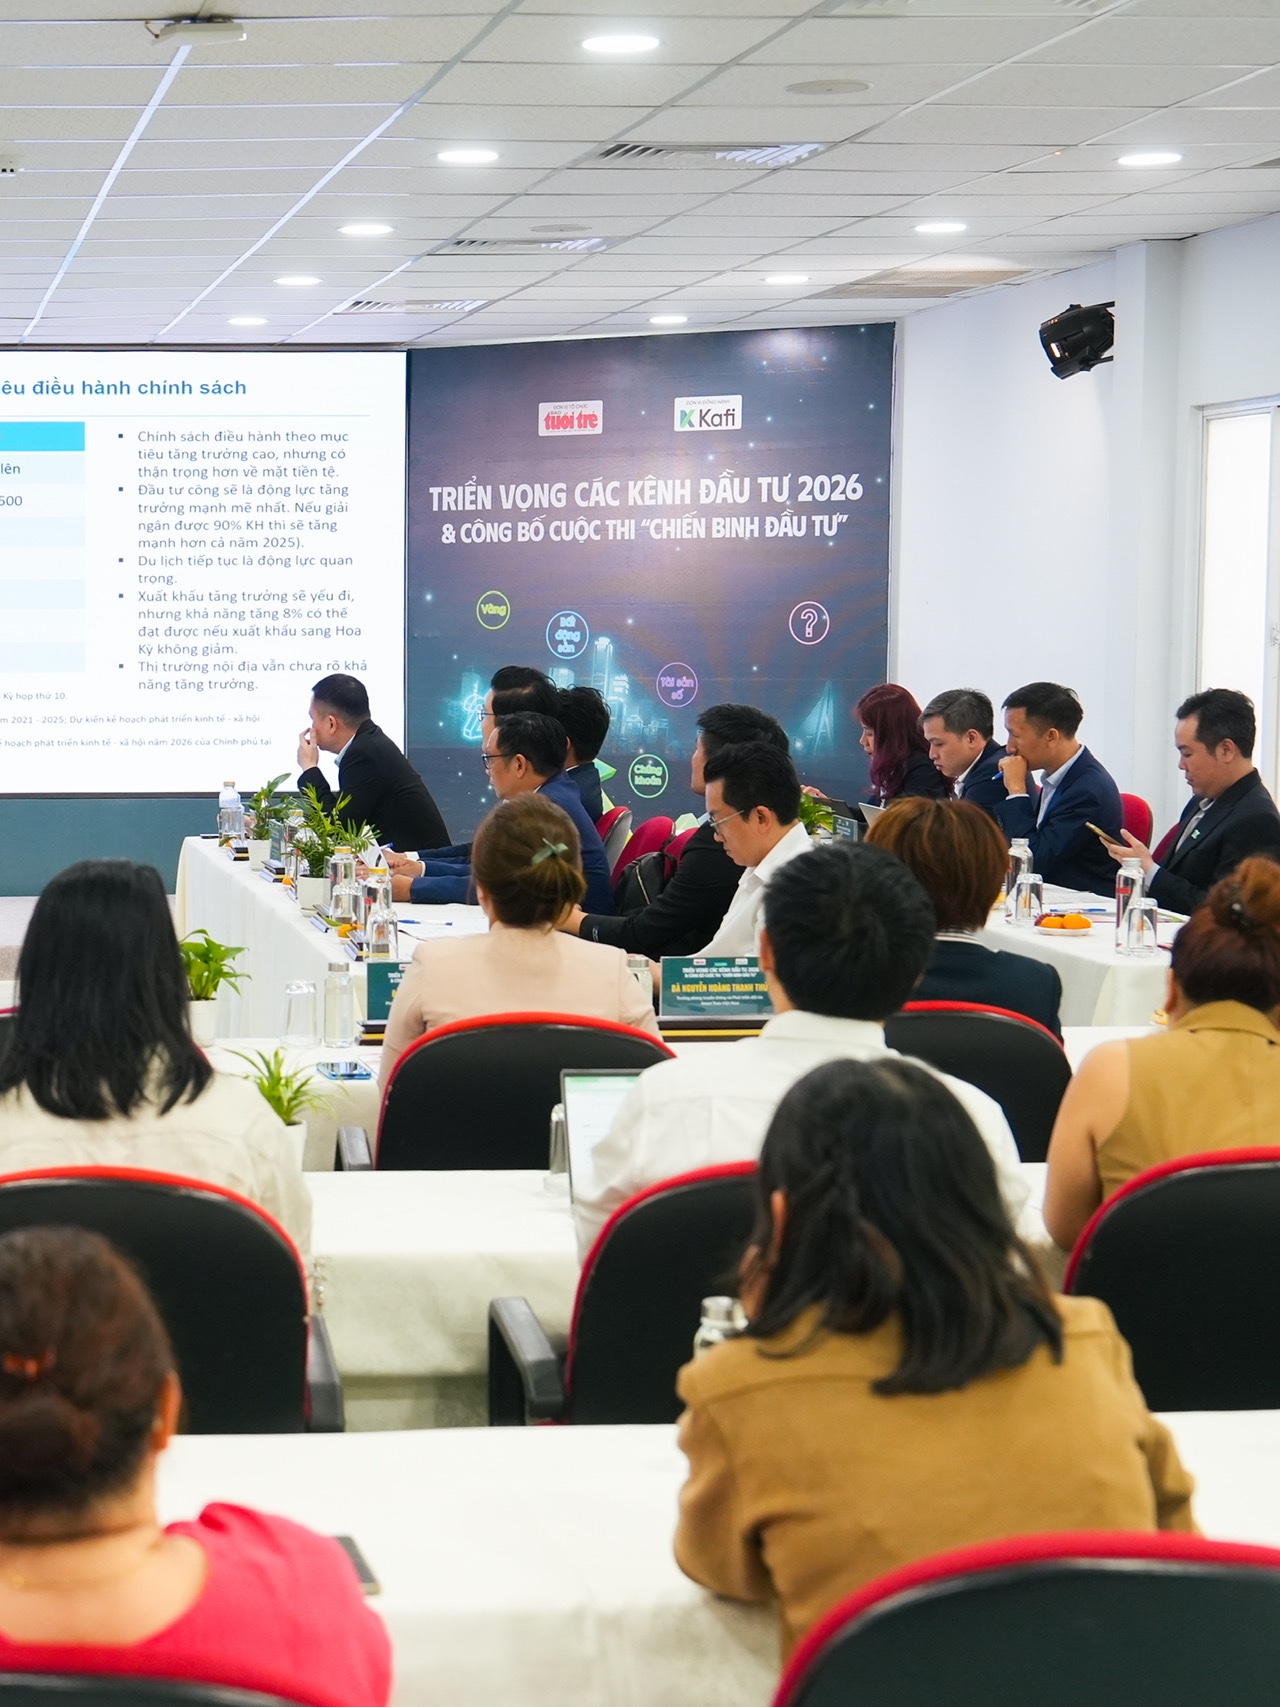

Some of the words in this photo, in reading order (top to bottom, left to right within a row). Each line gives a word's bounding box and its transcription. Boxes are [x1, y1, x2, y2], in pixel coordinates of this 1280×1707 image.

[32, 376, 75, 396] điều
[81, 379, 131, 396] hành
[137, 379, 193, 395] chính
[199, 379, 247, 395] sách
[699, 408, 735, 428] Kafi
[137, 430, 177, 443] Chính
[180, 430, 210, 443] sách
[213, 429, 244, 443] điều
[247, 430, 282, 442] hành
[285, 430, 317, 442] theo
[320, 433, 349, 444] mục
[137, 448, 164, 460] tiêu
[167, 448, 198, 462] tăng
[201, 447, 249, 462] trưởng
[251, 450, 279, 461] cao,
[283, 448, 327, 462] nhưng
[330, 448, 346, 460] có
[0, 462, 21, 475] lên
[137, 465, 169, 480] thận
[172, 467, 209, 481] trọng
[212, 465, 239, 478] hơn
[242, 464, 259, 478] về
[262, 465, 289, 479] mặt
[292, 464, 318, 478] tiền
[322, 465, 340, 479] tệ.
[429, 476, 492, 511] TRIỂN
[499, 484, 566, 512] VỌNG
[574, 477, 620, 507] CÁC
[628, 476, 691, 505] KÊNH
[699, 468, 749, 504] ĐẦU
[756, 473, 791, 502] TƯ
[798, 474, 863, 502] 2026
[441, 524, 455, 543] &
[460, 519, 511, 543] CÔNG
[518, 515, 545, 542] BỐ
[549, 516, 601, 544] CUỘC
[605, 520, 635, 540] THI
[640, 510, 706, 539] “CHIẾN
[712, 517, 759, 538] BINH
[765, 508, 807, 537] ĐẦU
[811, 514, 848, 537] TƯ”
[138, 555, 157, 567] Du
[160, 555, 184, 568] lịch
[187, 554, 214, 569] tiếp
[217, 556, 239, 568] tục
[242, 555, 254, 566] là
[257, 554, 292, 569] động
[295, 554, 316, 568] lực
[319, 557, 353, 568] quan
[137, 573, 178, 587] trọng.
[801, 609, 818, 637] ?
